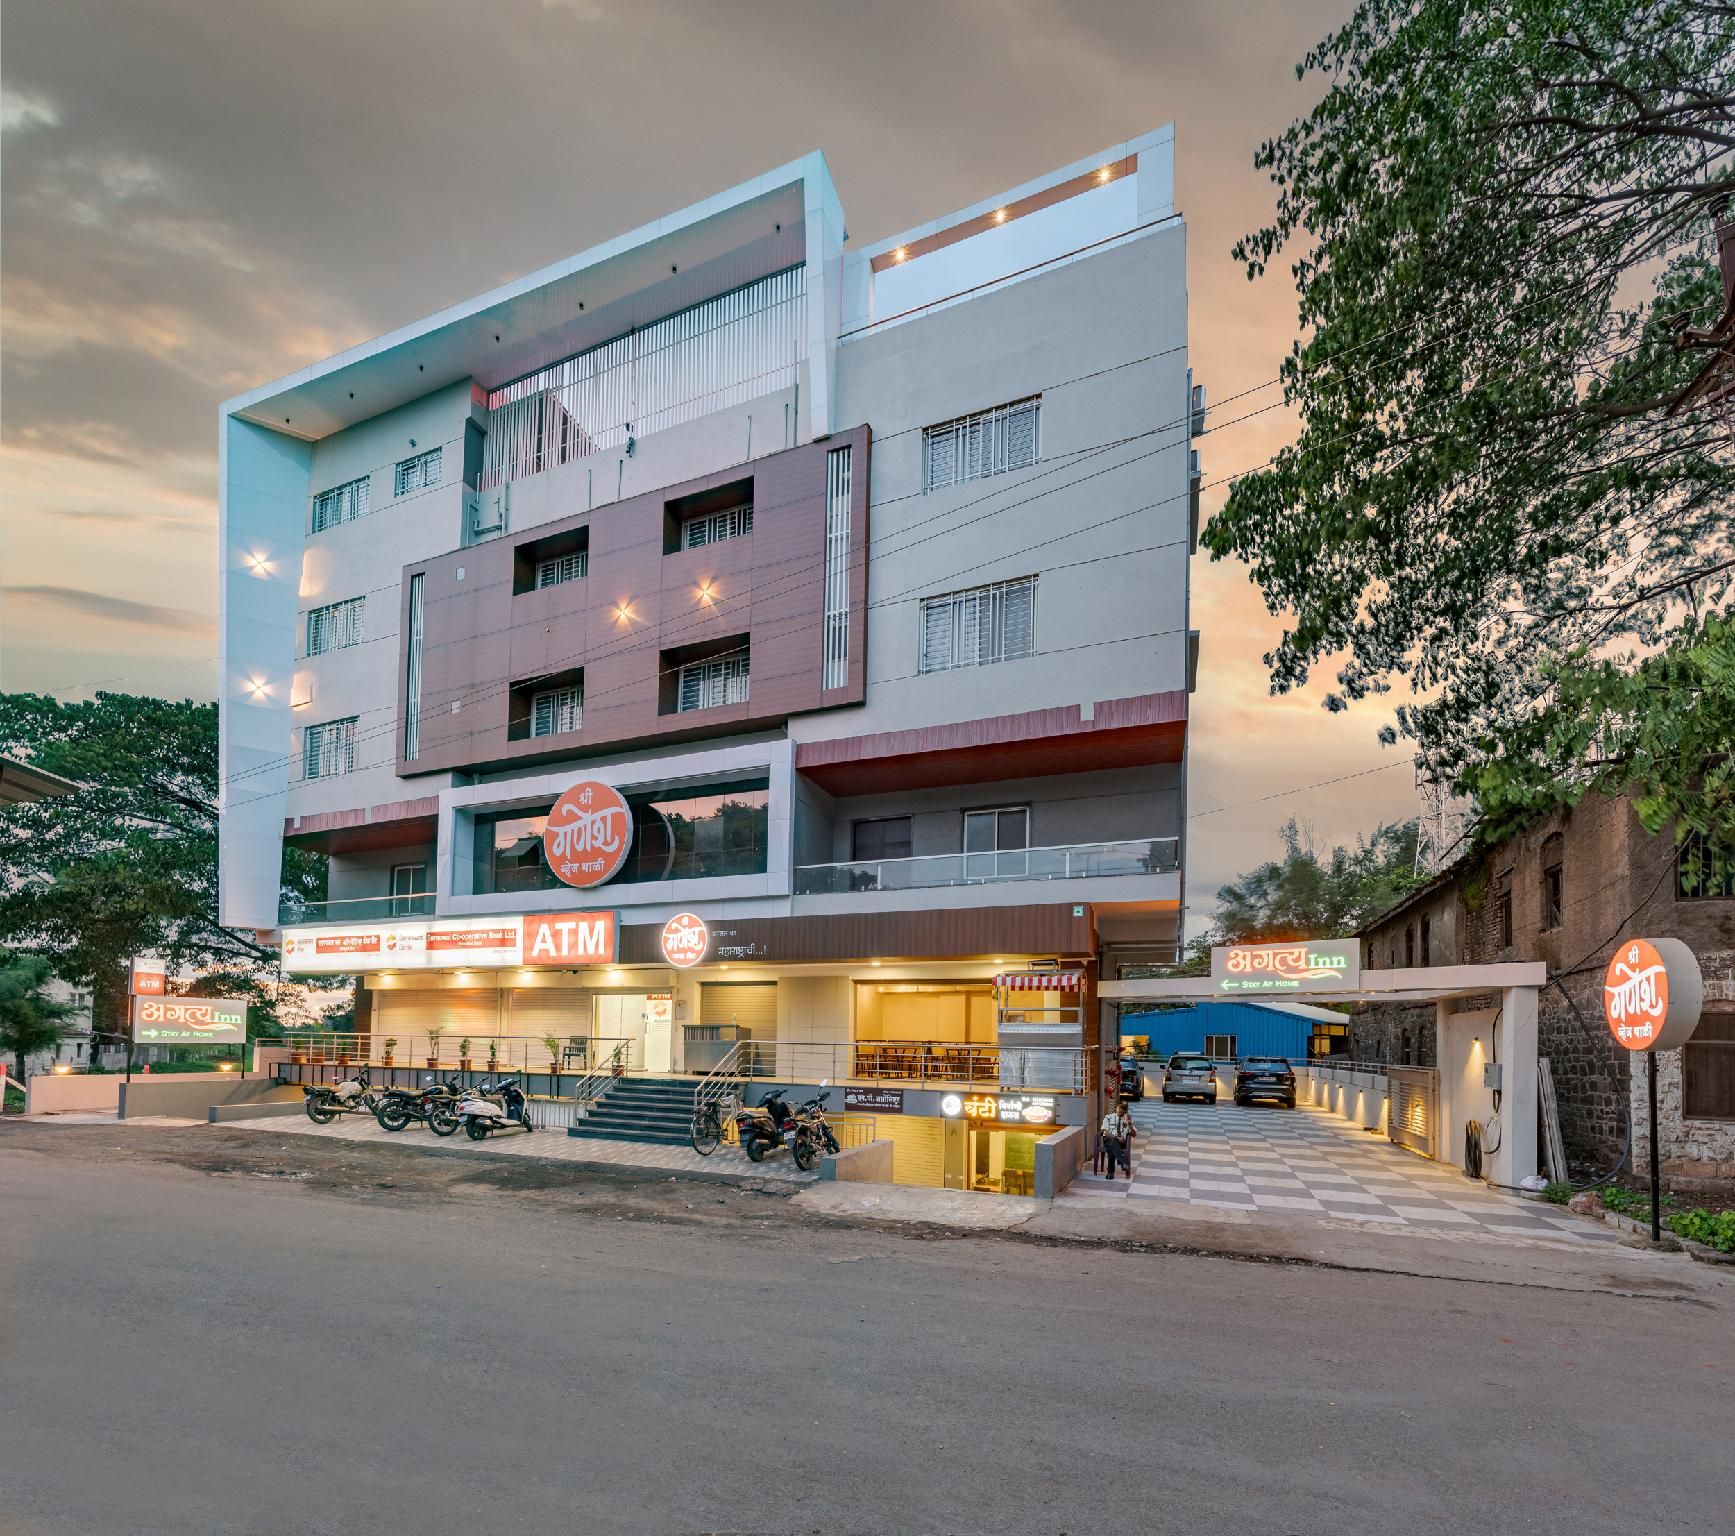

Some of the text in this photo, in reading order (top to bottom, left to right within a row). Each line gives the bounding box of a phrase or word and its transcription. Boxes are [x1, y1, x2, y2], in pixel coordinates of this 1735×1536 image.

[579, 788, 593, 804] श्री
[545, 804, 625, 858] गणेश
[531, 920, 606, 957] ATM
[664, 922, 706, 952] गणेश
[1308, 954, 1347, 969] Inn
[1628, 945, 1640, 964] श्री
[138, 980, 160, 989] ATM
[1605, 963, 1666, 1021] गणेश
[213, 1012, 242, 1024] Inn
[964, 1095, 997, 1118] बंटी
